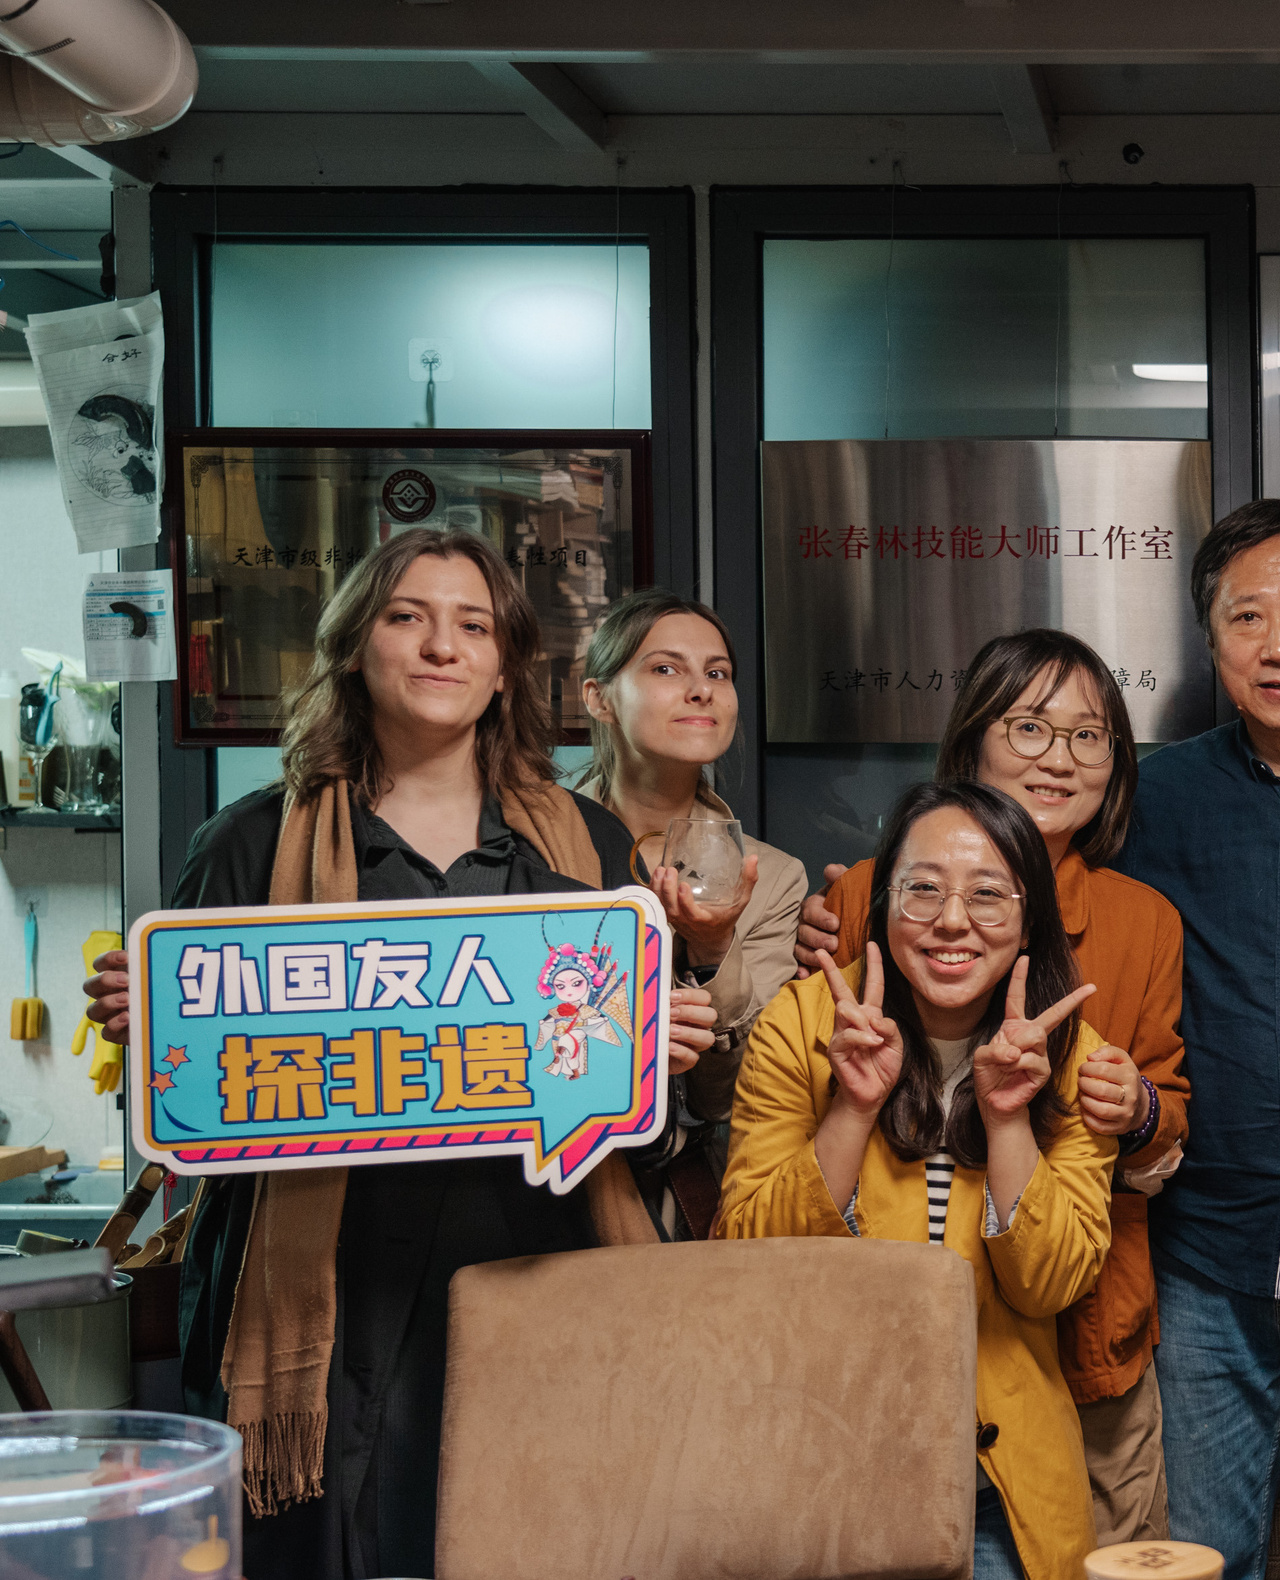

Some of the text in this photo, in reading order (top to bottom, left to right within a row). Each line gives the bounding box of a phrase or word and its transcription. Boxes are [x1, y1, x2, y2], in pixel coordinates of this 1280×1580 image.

[798, 523, 1174, 561] 张春林技能大师工作室
[176, 934, 514, 1018] 外国友人
[217, 1022, 535, 1125] 探非遗
